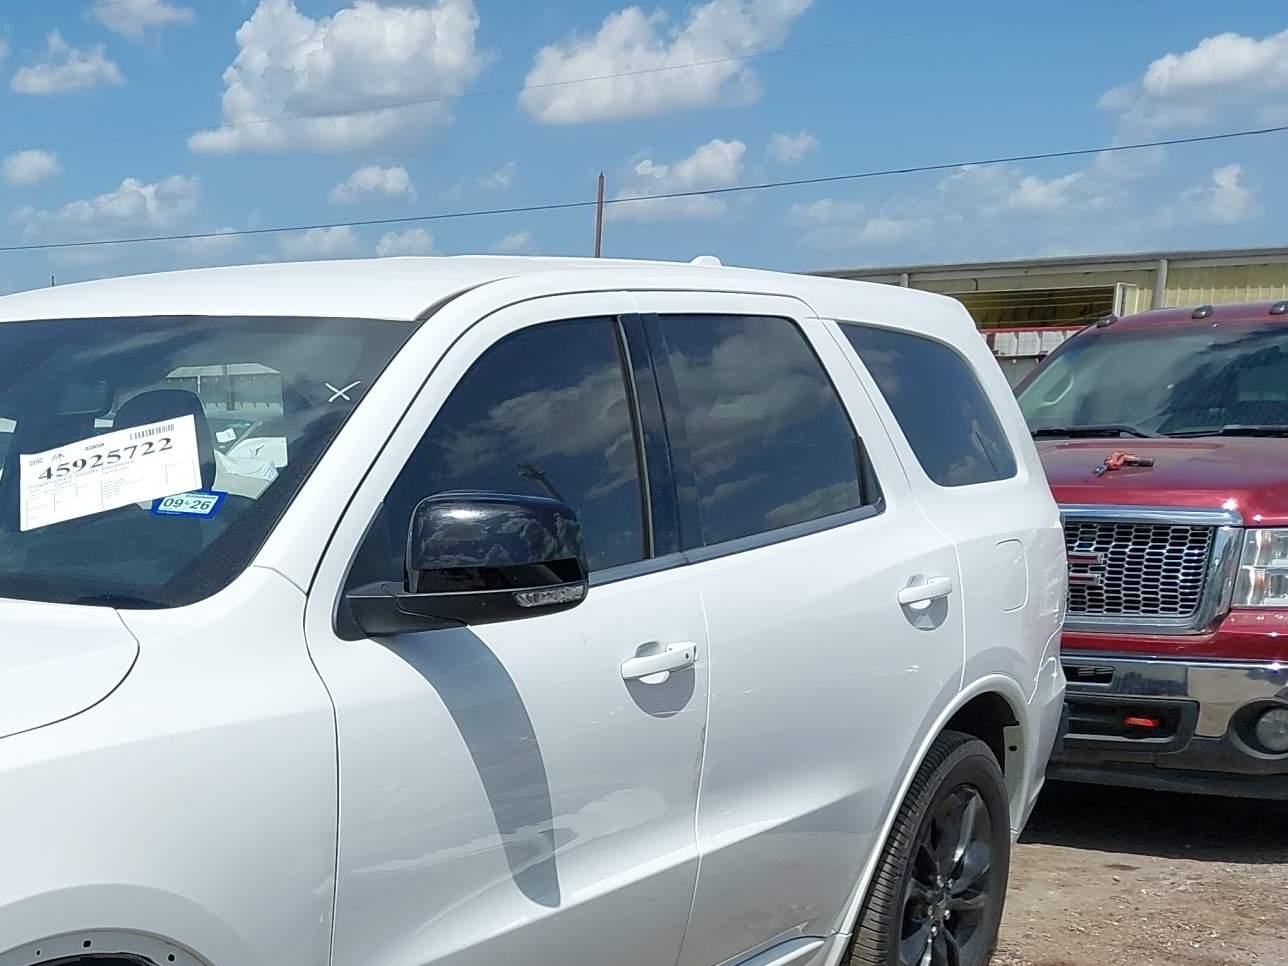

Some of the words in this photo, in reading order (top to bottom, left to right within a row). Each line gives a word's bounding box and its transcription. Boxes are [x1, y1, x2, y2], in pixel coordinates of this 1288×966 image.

[38, 437, 174, 480] 45925722
[163, 498, 184, 508] 09
[189, 499, 212, 510] 26
